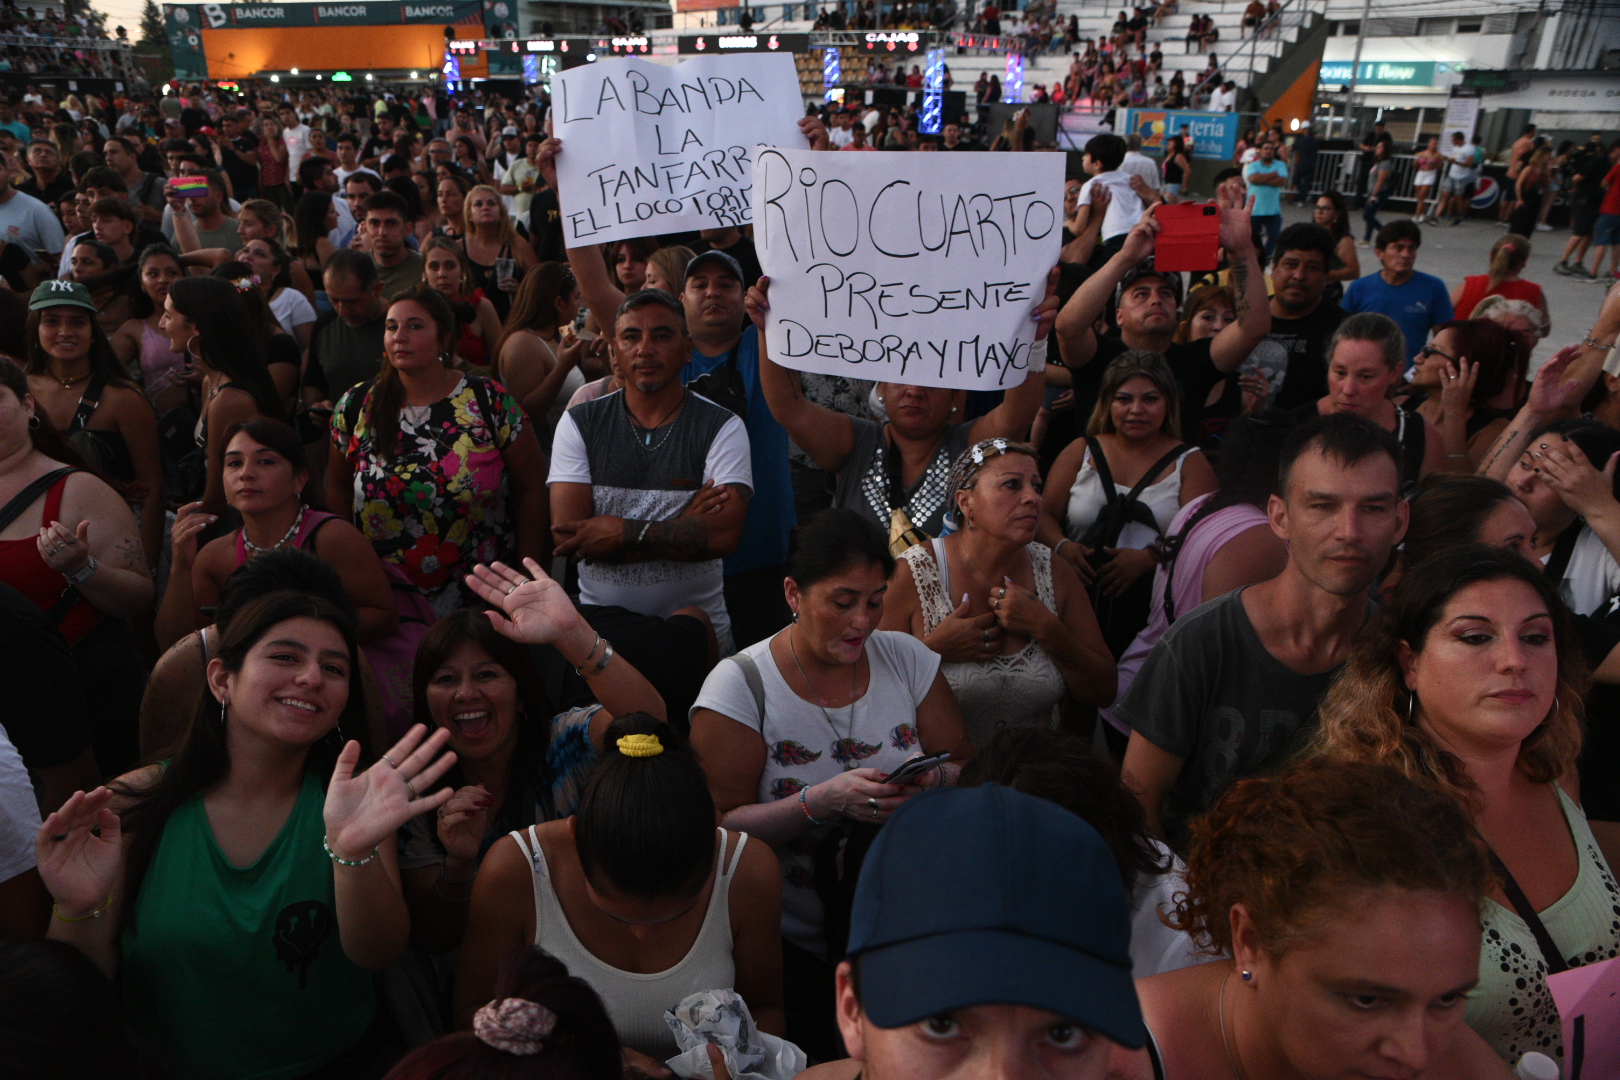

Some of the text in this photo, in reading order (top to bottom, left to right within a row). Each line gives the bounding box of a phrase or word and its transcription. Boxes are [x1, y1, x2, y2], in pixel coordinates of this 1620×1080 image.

[235, 7, 285, 19] BANCOR
[317, 6, 367, 18] BANCOR
[404, 5, 454, 18] BANCOR
[866, 33, 921, 43] CAJAS
[562, 69, 764, 124] LA BANDA
[655, 124, 703, 155] LA
[1168, 115, 1225, 138] Ltería
[587, 145, 752, 206] FANFARR
[567, 208, 611, 238] EL
[615, 198, 684, 224] LOCO
[868, 179, 1055, 266] CUARTO
[51, 279, 74, 292] NY
[806, 263, 1030, 330] PRESENTE
[779, 319, 922, 376] DEBORA
[927, 339, 948, 378] Y
